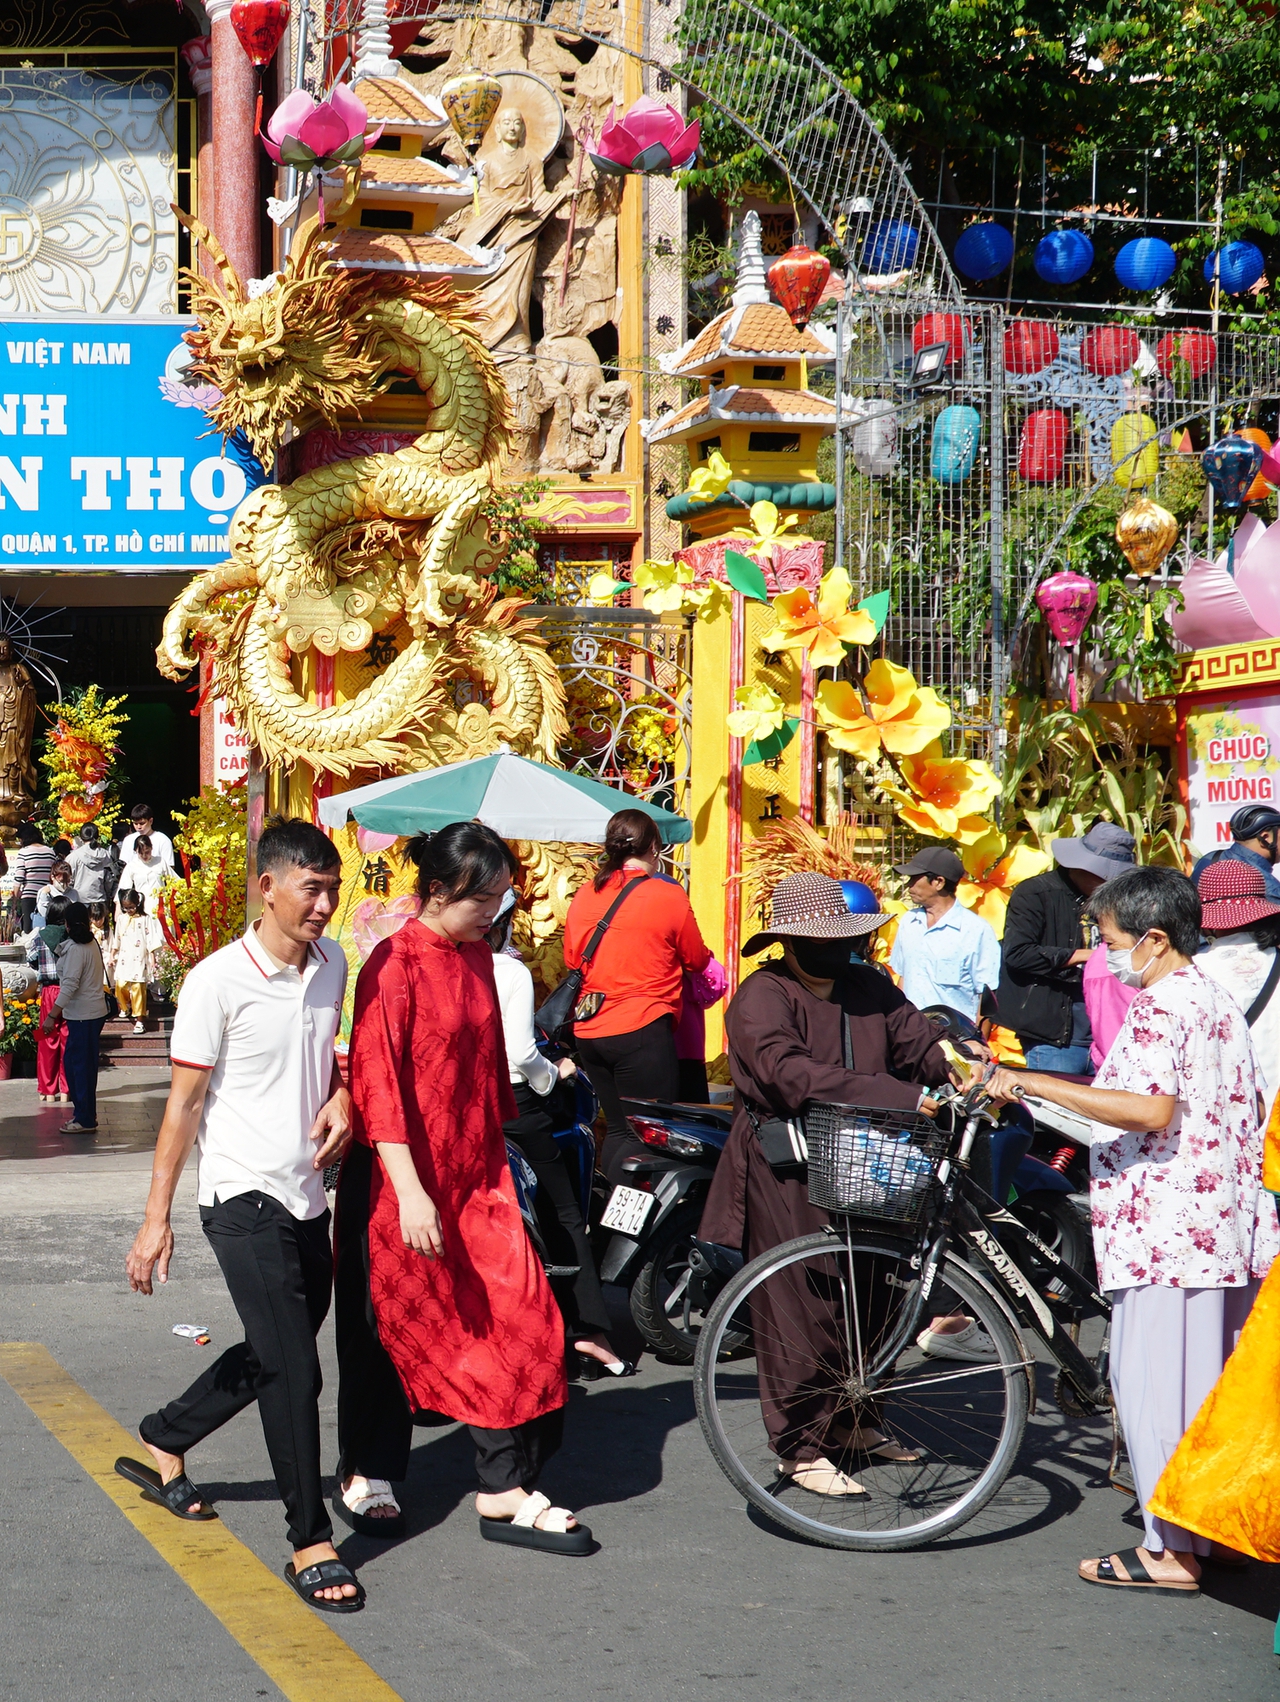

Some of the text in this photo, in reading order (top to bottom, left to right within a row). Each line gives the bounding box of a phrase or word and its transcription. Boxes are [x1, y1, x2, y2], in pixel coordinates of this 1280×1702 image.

[6, 338, 64, 368] VIỆT
[72, 343, 131, 365] NAM
[70, 456, 247, 524] THỌ
[2, 532, 56, 556] QUẬN
[62, 535, 77, 554] 1,
[83, 535, 109, 552] TP.
[115, 529, 143, 552] HỒ
[149, 532, 185, 552] CHÍ
[192, 535, 229, 552] MIN
[1208, 733, 1267, 763] CHÚC
[1208, 776, 1272, 803] MỪNG
[615, 1188, 648, 1213] 59-TA
[969, 1230, 1027, 1298] ASAMA
[921, 1262, 938, 1301] ASAMA
